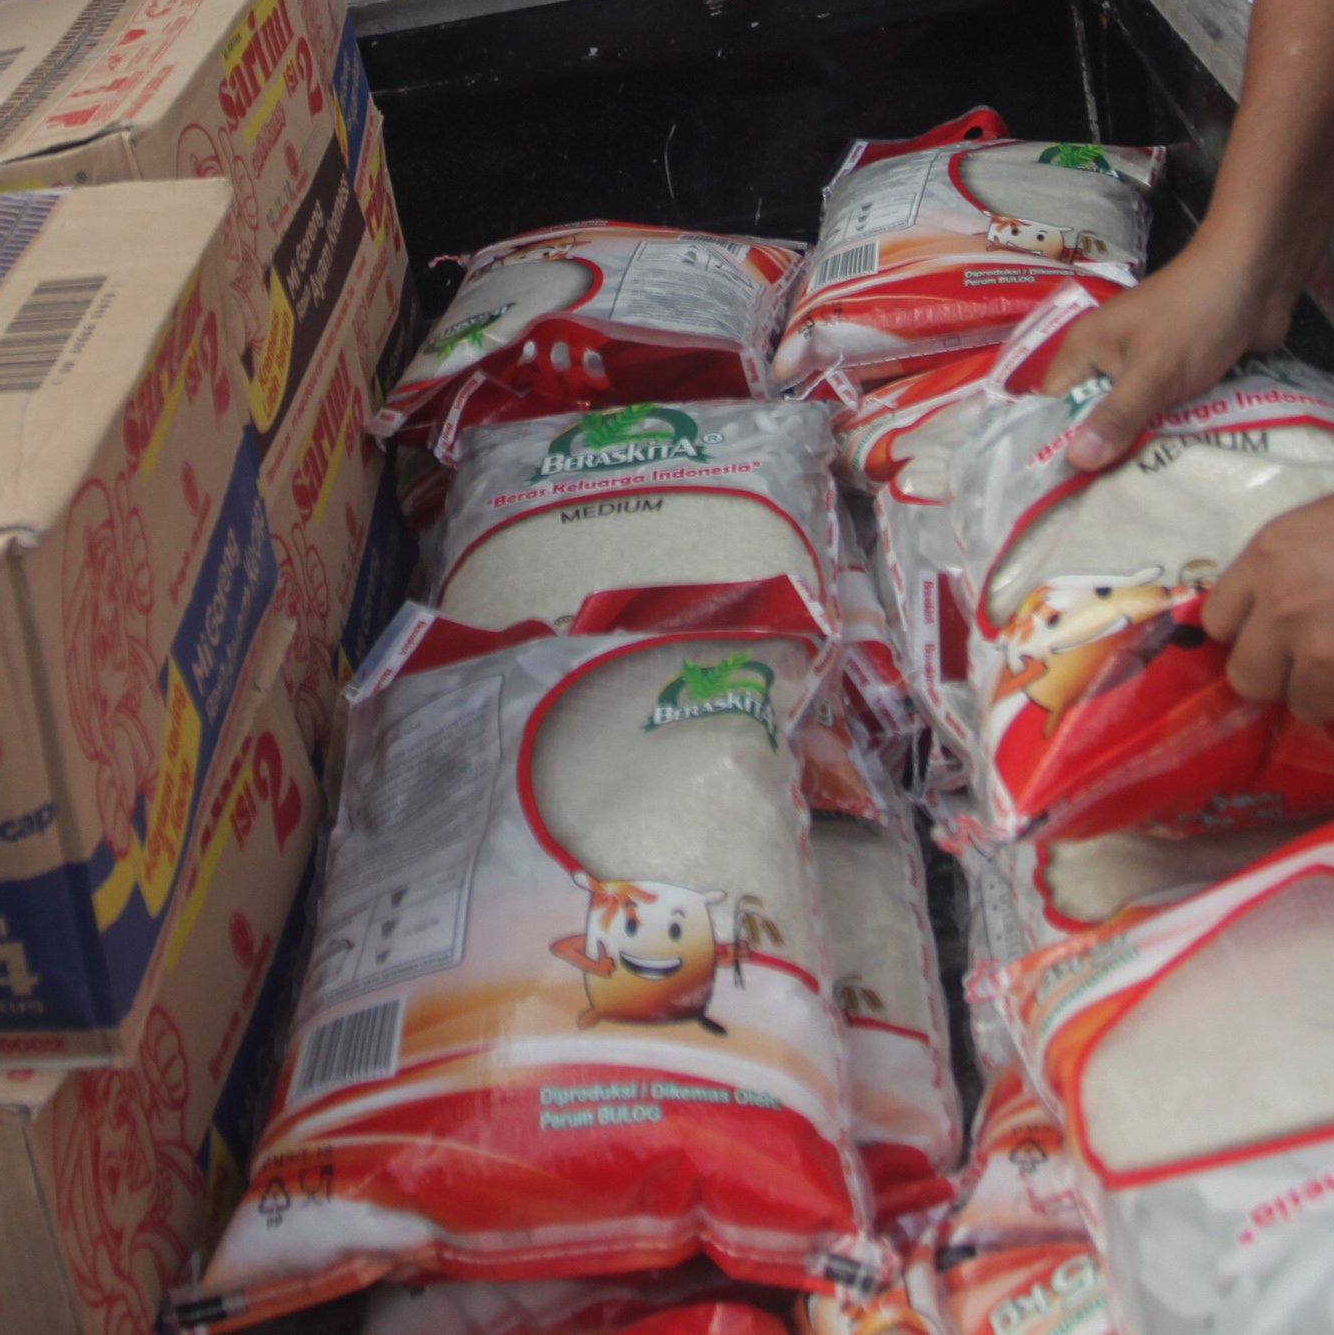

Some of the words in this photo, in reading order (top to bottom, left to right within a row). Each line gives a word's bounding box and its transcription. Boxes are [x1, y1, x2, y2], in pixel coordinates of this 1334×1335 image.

[296, 36, 323, 118] 2
[295, 198, 326, 269] Goreng
[998, 275, 1036, 284] BULOG
[200, 311, 232, 418] 2
[1137, 432, 1270, 473] MEDIUM
[553, 474, 646, 495] Keluarga
[560, 498, 664, 525] MEDIUM
[205, 526, 241, 641] Goreng
[229, 777, 258, 850] ISI
[252, 729, 302, 858] 2
[540, 1082, 637, 1106] Diproduksi
[650, 1080, 730, 1103] Dikemas
[540, 1110, 594, 1131] Perum
[597, 1105, 662, 1126] BULOG
